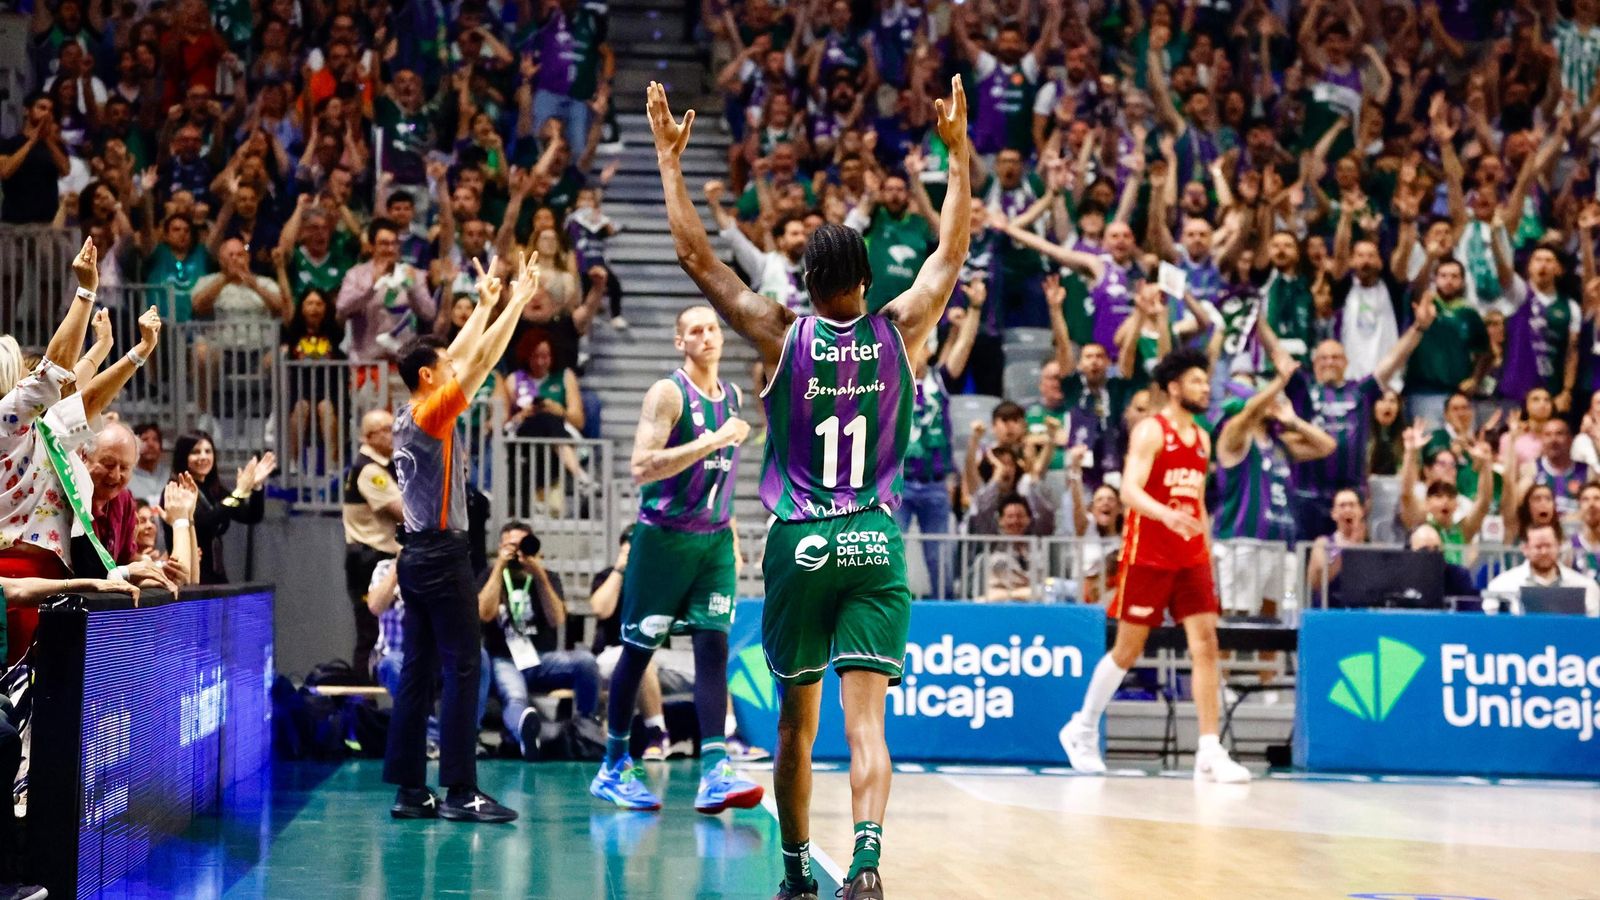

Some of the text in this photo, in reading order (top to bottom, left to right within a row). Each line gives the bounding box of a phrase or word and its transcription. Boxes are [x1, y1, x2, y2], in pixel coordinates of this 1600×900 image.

[810, 338, 882, 362] Carter
[815, 415, 867, 488] 11
[836, 531, 889, 545] COSTA
[836, 543, 890, 556] DEL SOL
[837, 555, 890, 568] MÁLAGA
[905, 633, 1083, 678] ndación
[885, 674, 1014, 730] nicaja
[1442, 685, 1600, 742] Unicaj
